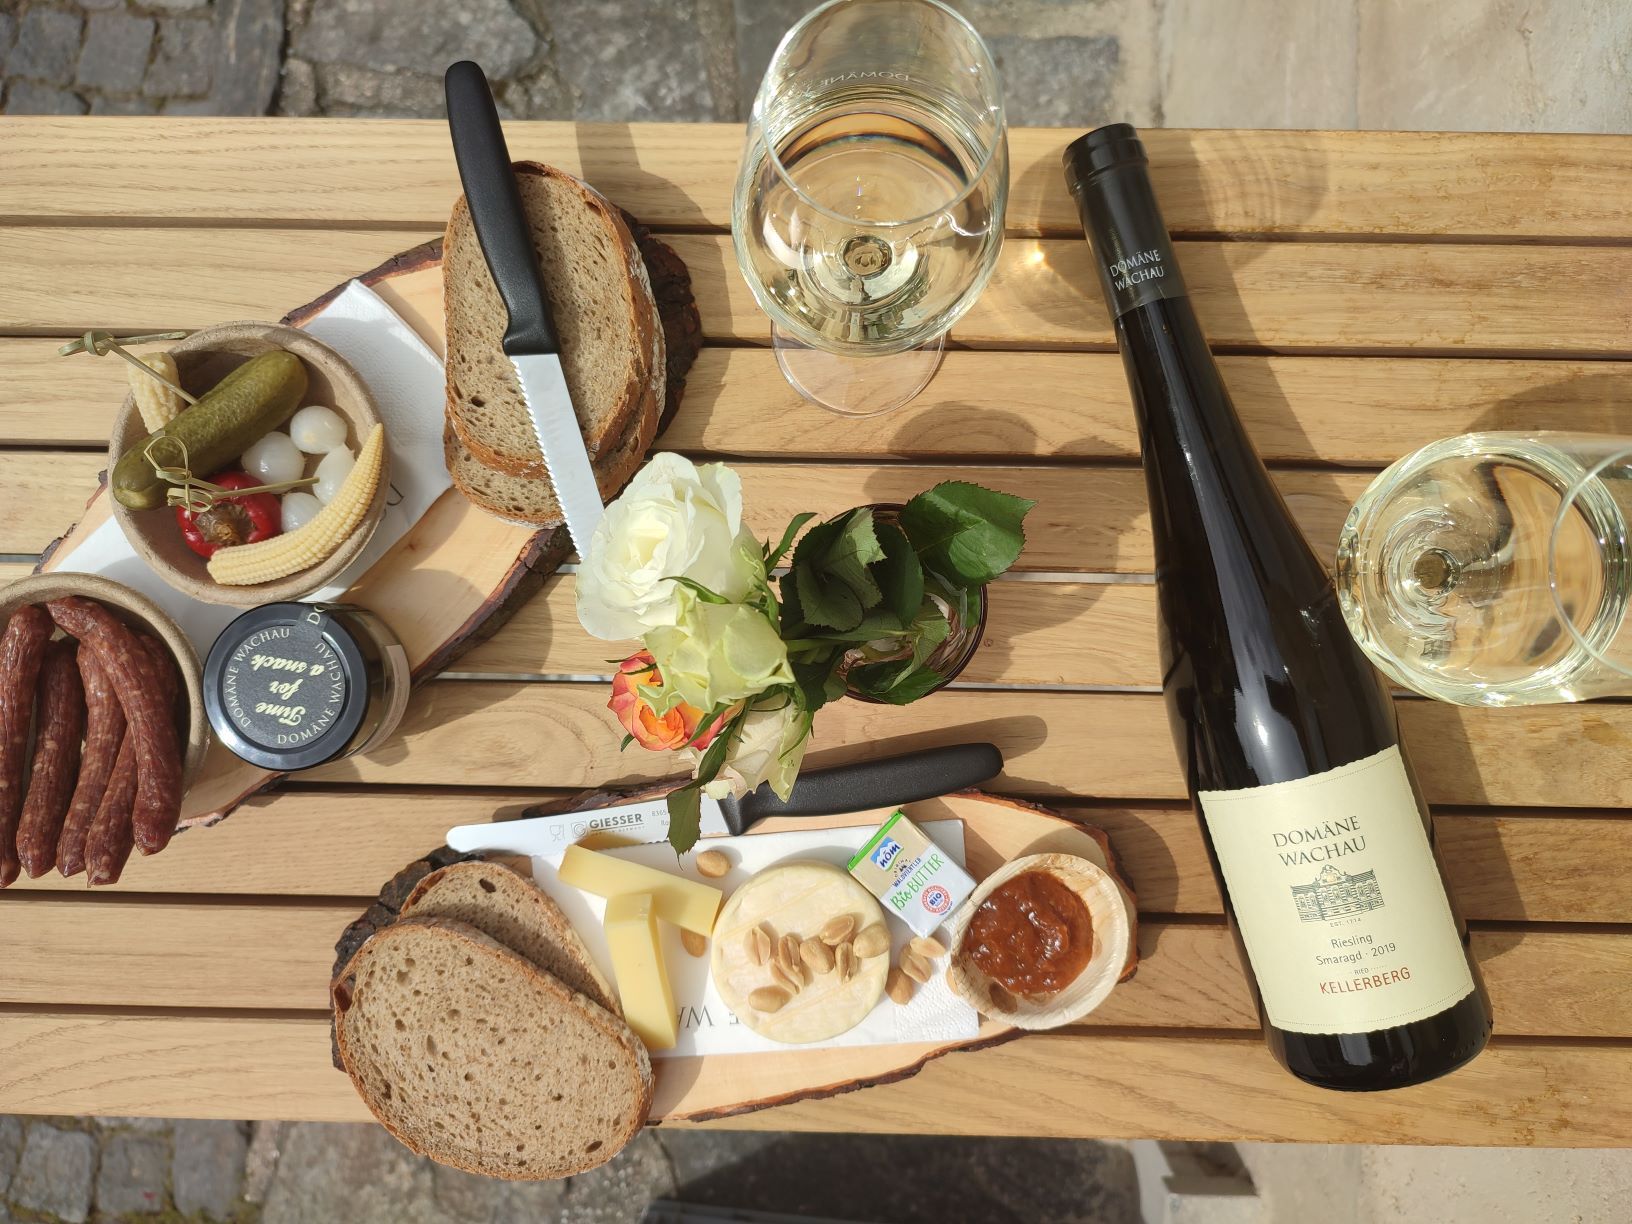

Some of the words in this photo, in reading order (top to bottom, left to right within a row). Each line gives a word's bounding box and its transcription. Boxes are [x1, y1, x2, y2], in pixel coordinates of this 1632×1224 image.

[1110, 249, 1161, 277] DOMÄNE
[1115, 266, 1164, 291] WACHAU
[234, 628, 290, 663] WACHAU
[250, 653, 308, 674] snack
[309, 664, 325, 676] a
[223, 666, 252, 728] DOMÄNE
[269, 678, 303, 700] for
[277, 707, 335, 744] DOMÄNE
[315, 642, 343, 703] WACHAU
[255, 702, 306, 726] Time
[589, 813, 643, 828] GIESSER
[1272, 815, 1361, 848] DOMÄNE
[1278, 835, 1366, 867] WACHAU
[929, 892, 942, 906] BIO
[1331, 933, 1373, 949] Riesling
[1315, 949, 1363, 967] Smaragd
[1371, 942, 1396, 958] 2019
[1319, 966, 1411, 995] KELLERBERG
[1354, 968, 1369, 976] RIED
